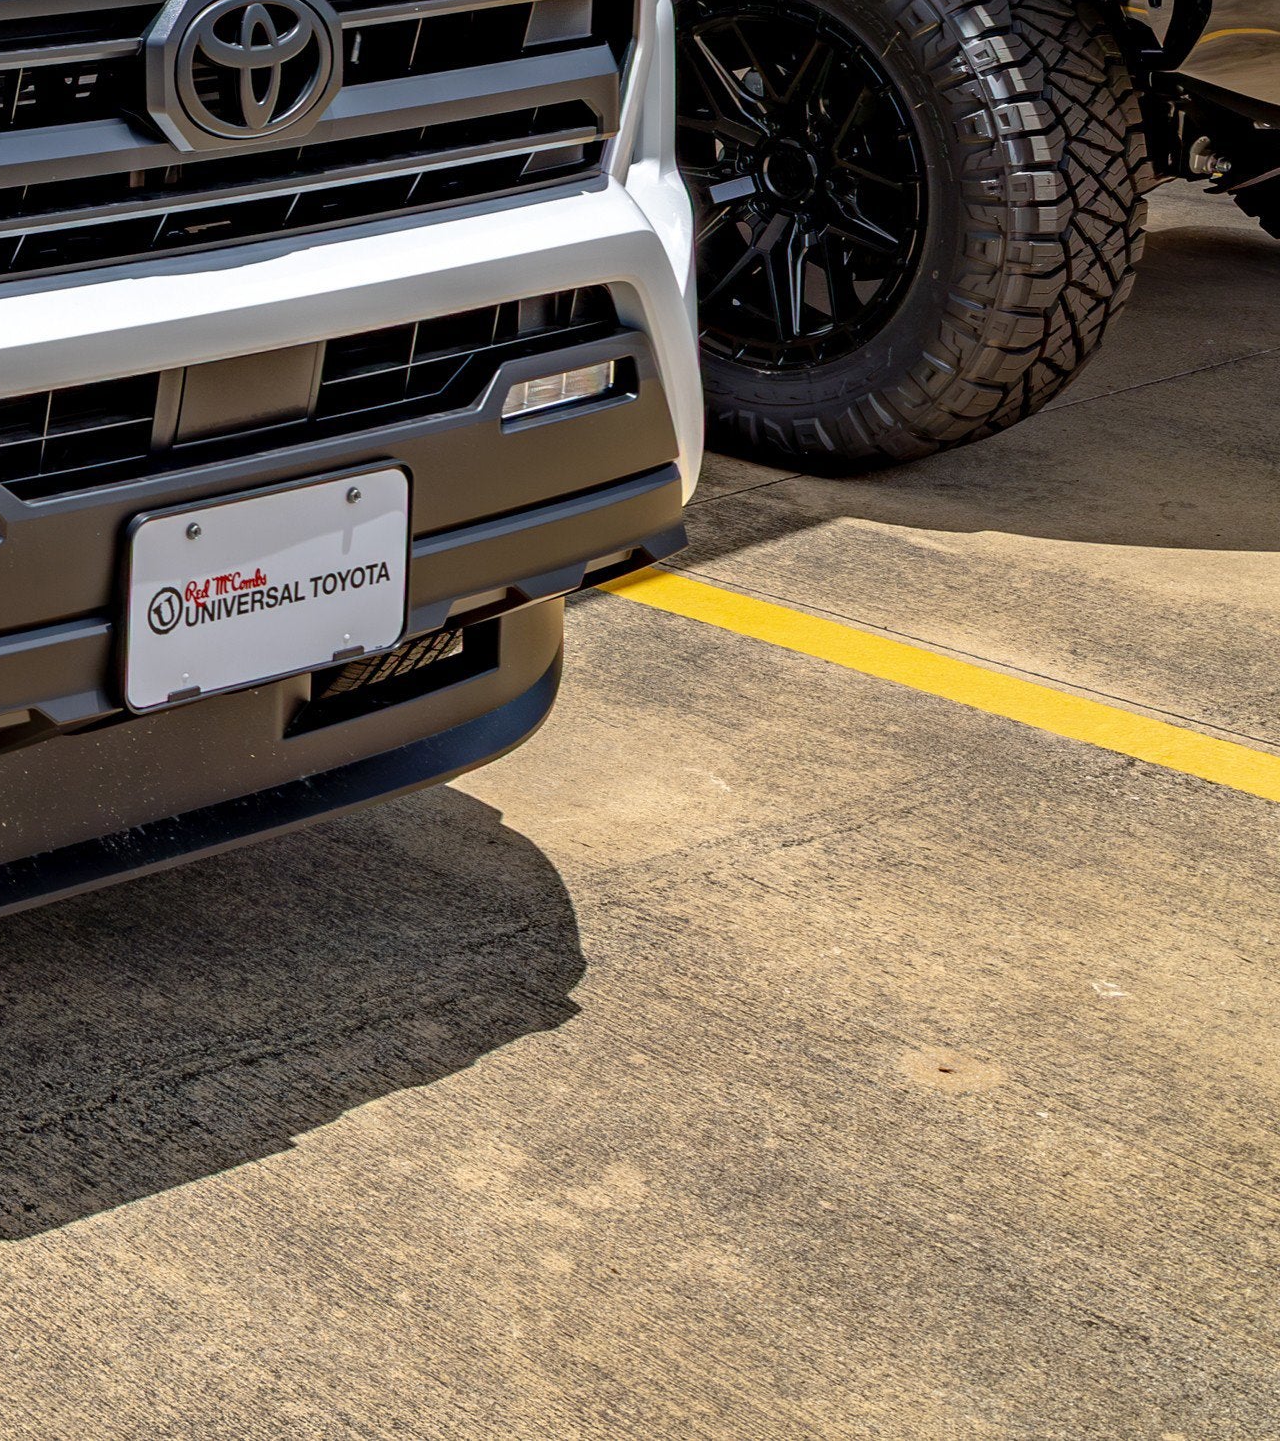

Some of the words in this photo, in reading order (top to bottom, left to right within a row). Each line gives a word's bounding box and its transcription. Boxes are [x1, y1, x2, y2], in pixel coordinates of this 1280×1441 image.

[185, 579, 211, 607] Red
[185, 581, 306, 627] UNIVERSAL
[309, 561, 391, 598] TOYOTA
